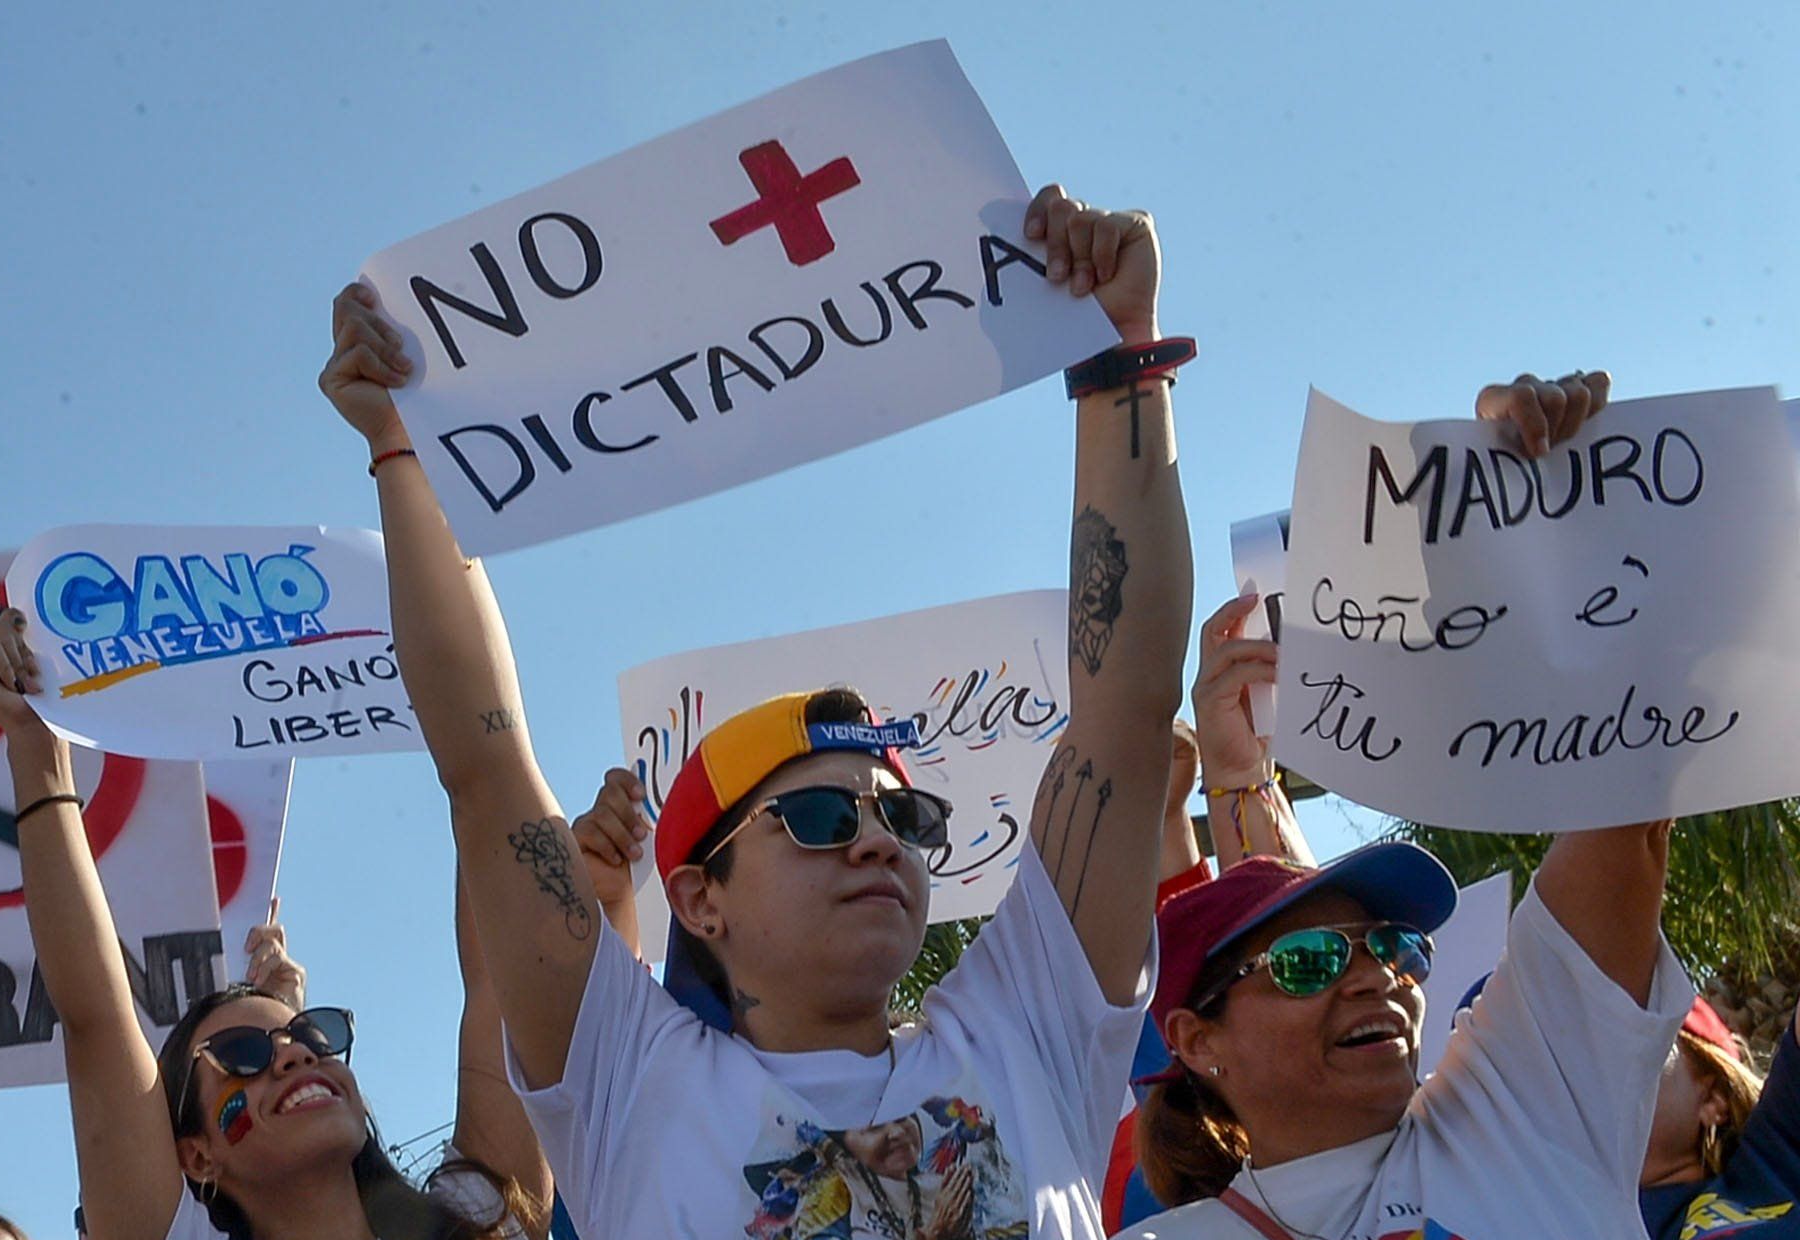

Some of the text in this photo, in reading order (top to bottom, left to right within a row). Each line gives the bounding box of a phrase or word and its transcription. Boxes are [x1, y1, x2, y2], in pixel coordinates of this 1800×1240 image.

[408, 211, 604, 370] NO
[438, 234, 1047, 513] DICTADURA
[1364, 427, 1704, 545] MADURO
[62, 612, 329, 679] VENEZUELA
[1310, 576, 1508, 653] coño
[233, 705, 413, 749] LIBER
[820, 725, 918, 745] VENEZUELA
[1299, 672, 1740, 768] tu madre
